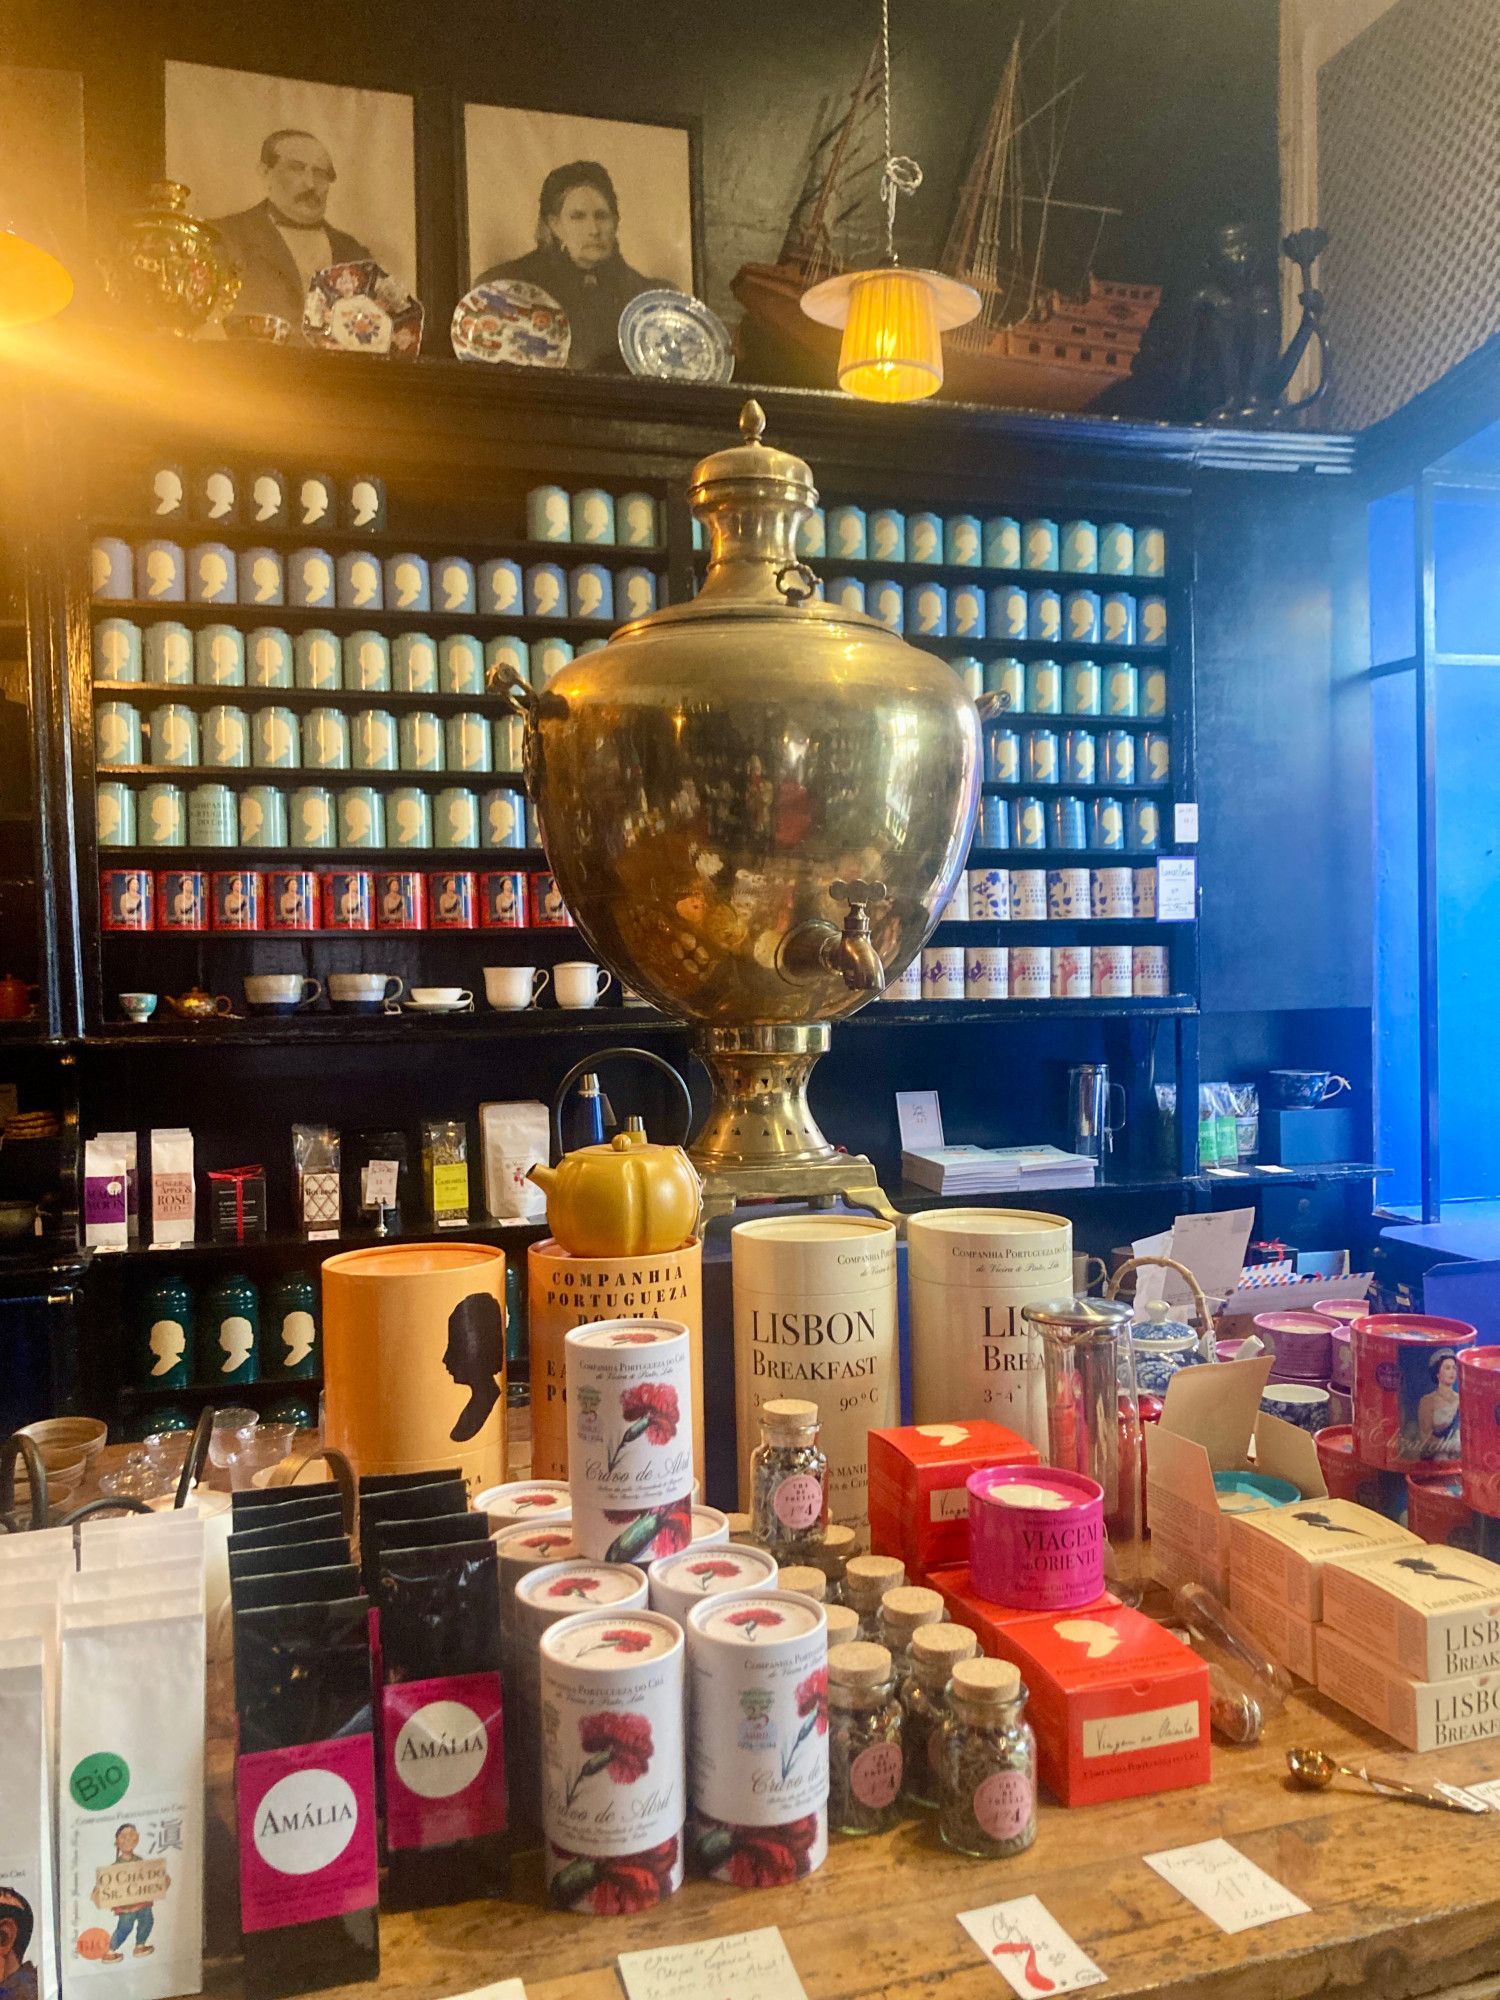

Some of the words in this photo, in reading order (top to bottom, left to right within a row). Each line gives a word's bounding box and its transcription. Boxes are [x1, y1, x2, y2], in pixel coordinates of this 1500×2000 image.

[837, 1250, 880, 1265] COMPANHIA
[952, 1247, 1004, 1259] COMPANHIA
[552, 1266, 683, 1288] COMPANHIA
[546, 1285, 688, 1308] PORTUGUEZA
[752, 1308, 877, 1346] LISBON
[753, 1349, 878, 1381] BREAKFAST
[1022, 1523, 1097, 1552] VIAGEM
[400, 1732, 485, 1763] AMÁLIA
[75, 1765, 123, 1802] Bio
[259, 1803, 353, 1838] AMÁLIA
[115, 1868, 145, 1885] CHÁ
